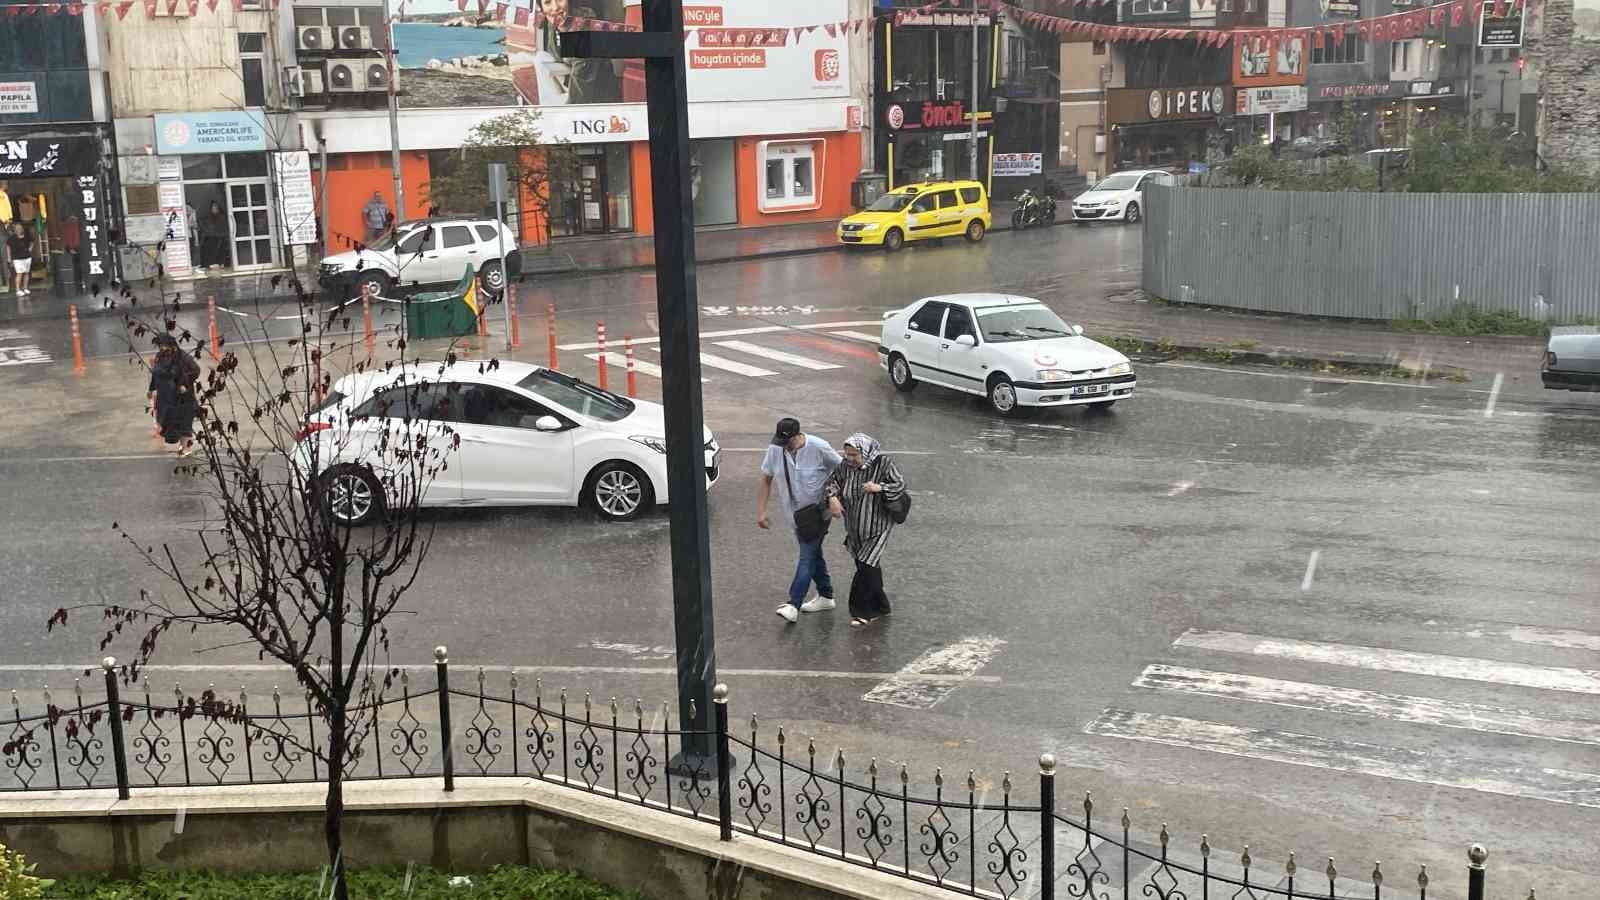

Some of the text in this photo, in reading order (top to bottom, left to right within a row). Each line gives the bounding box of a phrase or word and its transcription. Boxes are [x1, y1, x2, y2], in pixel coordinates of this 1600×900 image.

[685, 9, 720, 24] ING'yle
[694, 52, 731, 67] hayatın
[197, 126, 253, 135] AMERICANLIFE
[573, 119, 606, 134] ING
